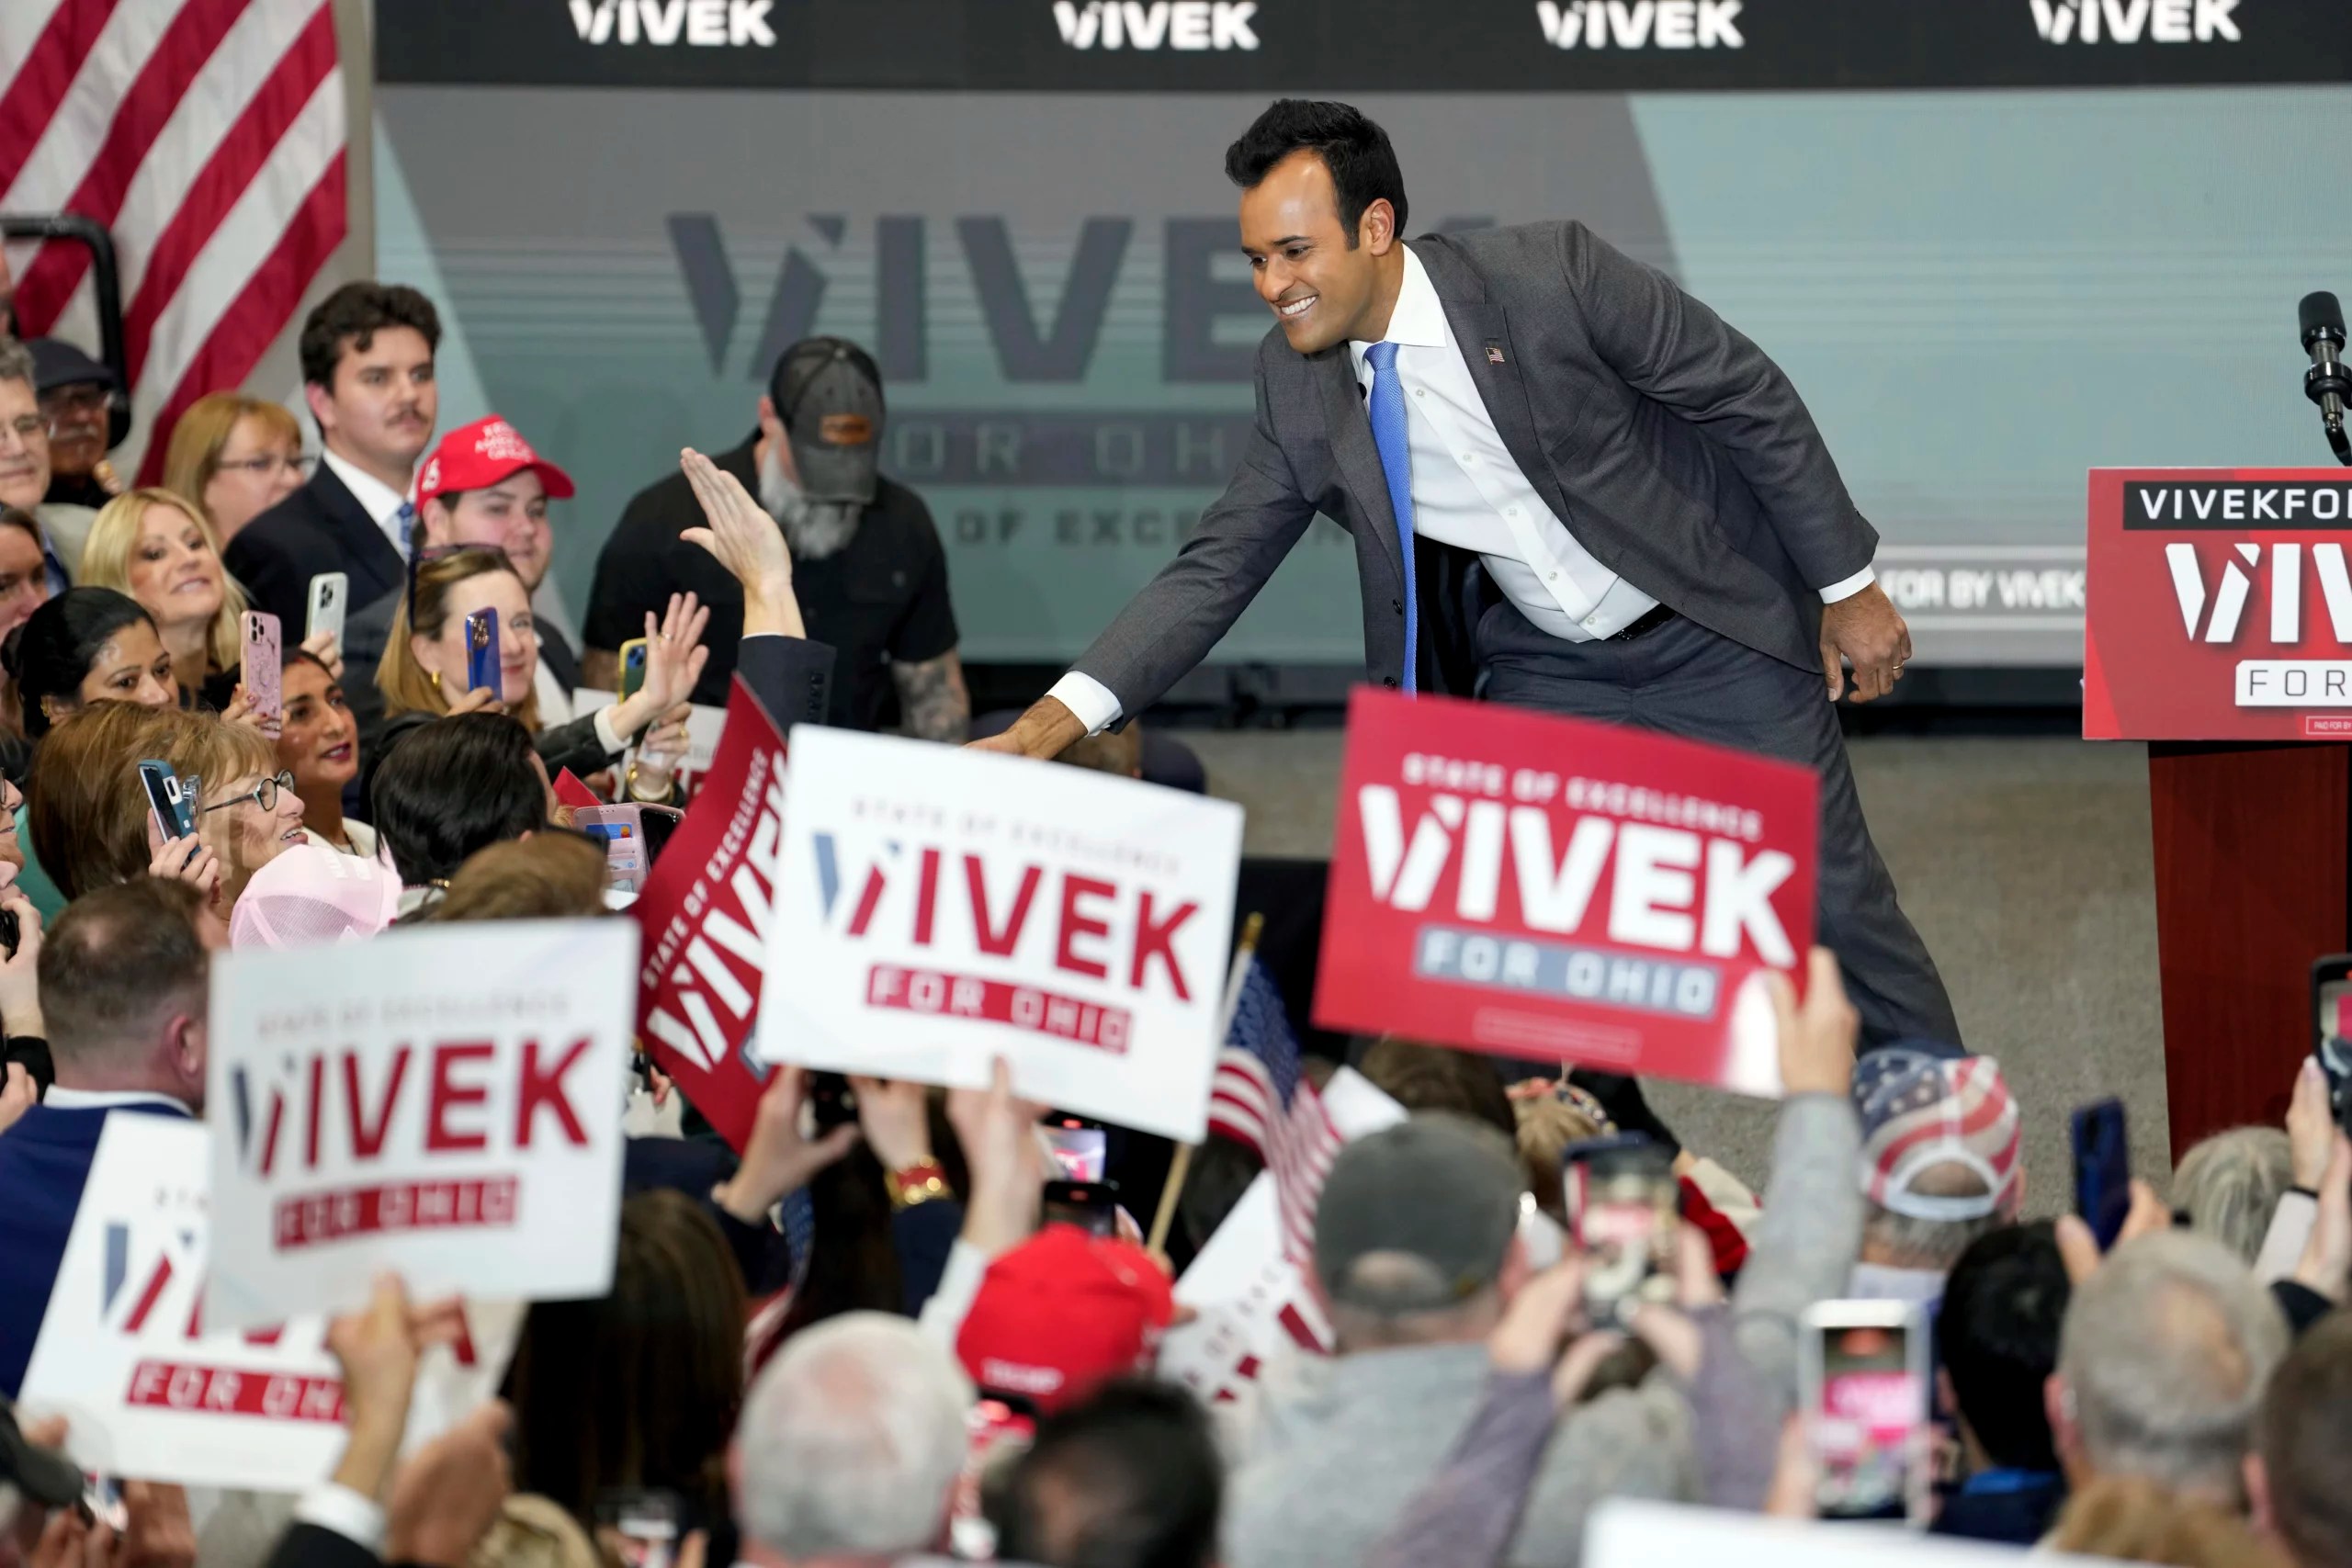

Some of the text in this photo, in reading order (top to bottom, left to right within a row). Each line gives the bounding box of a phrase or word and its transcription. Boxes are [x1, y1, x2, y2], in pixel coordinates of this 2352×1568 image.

[569, 0, 778, 46] VIVEK
[1053, 0, 1260, 50] VIVEK
[1536, 0, 1745, 49] VIVEK
[2029, 0, 2242, 44] VIVEK
[667, 213, 1255, 383] VIVE
[895, 423, 1226, 476] OR OH
[2140, 488, 2352, 520] VIVEKFO
[2249, 670, 2346, 696] FOR
[1402, 751, 1764, 843] STATE OF EXCELLENCE
[1359, 783, 1797, 969] VIVEK
[812, 831, 1201, 1003] VIVEK
[1422, 929, 1716, 1014] FOR OHIO
[871, 966, 1130, 1052] FOR OHIO
[232, 1032, 595, 1179] VIVEK
[133, 1362, 242, 1412] FOR
